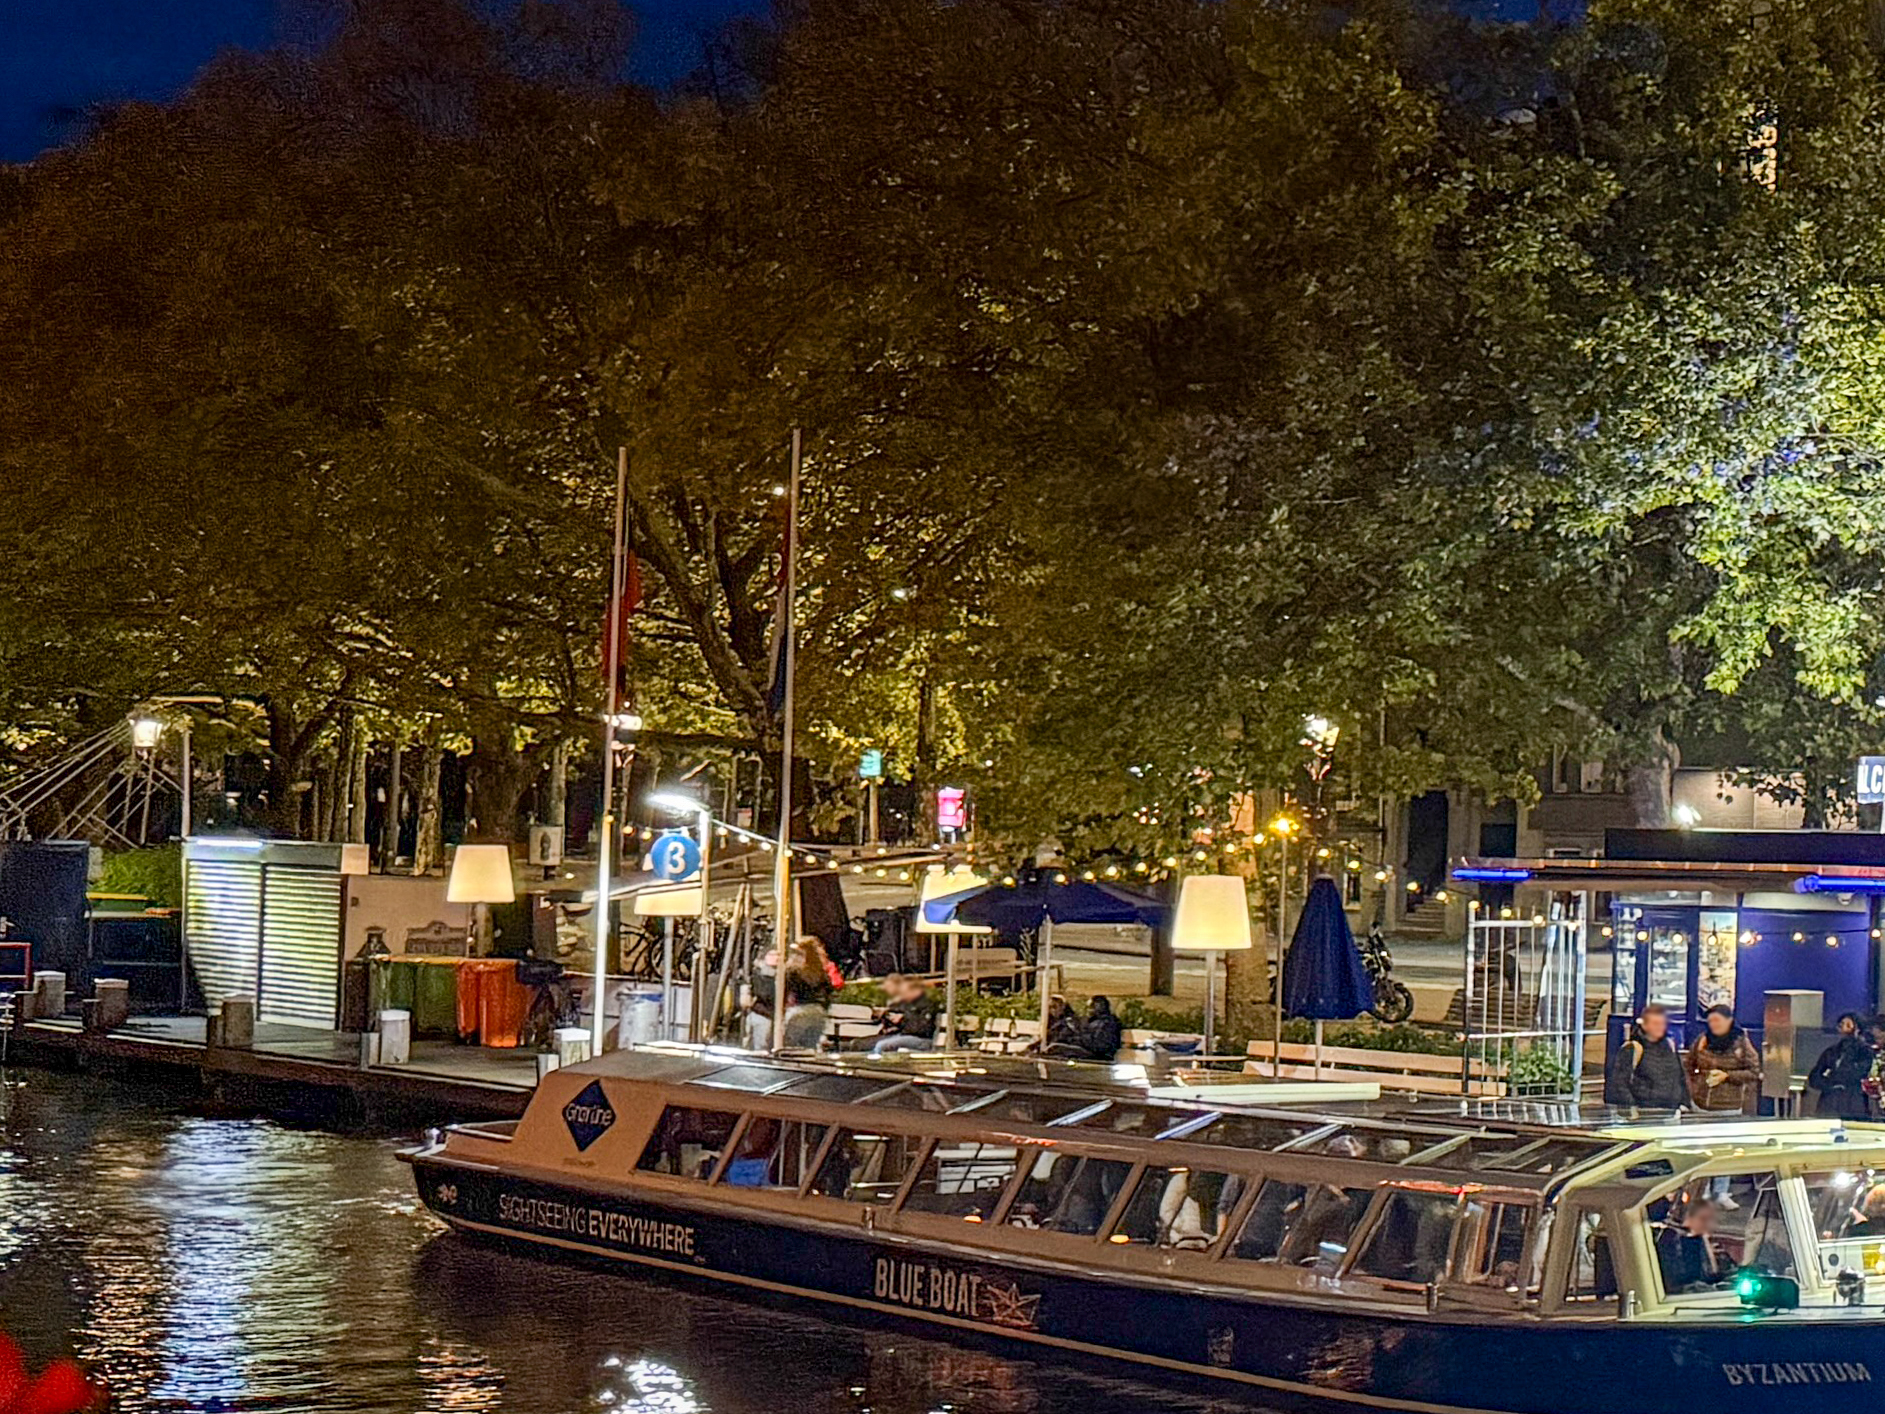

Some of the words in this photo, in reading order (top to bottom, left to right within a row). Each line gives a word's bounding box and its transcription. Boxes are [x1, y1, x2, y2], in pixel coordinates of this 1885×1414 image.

[668, 841, 686, 874] 3
[499, 1193, 587, 1234] SIGHTSEEING
[588, 1208, 695, 1256] EVERYWHERE
[873, 1258, 925, 1307] BLUE
[929, 1268, 982, 1317] BOAT
[1722, 1362, 1872, 1385] BYZANTIUM
